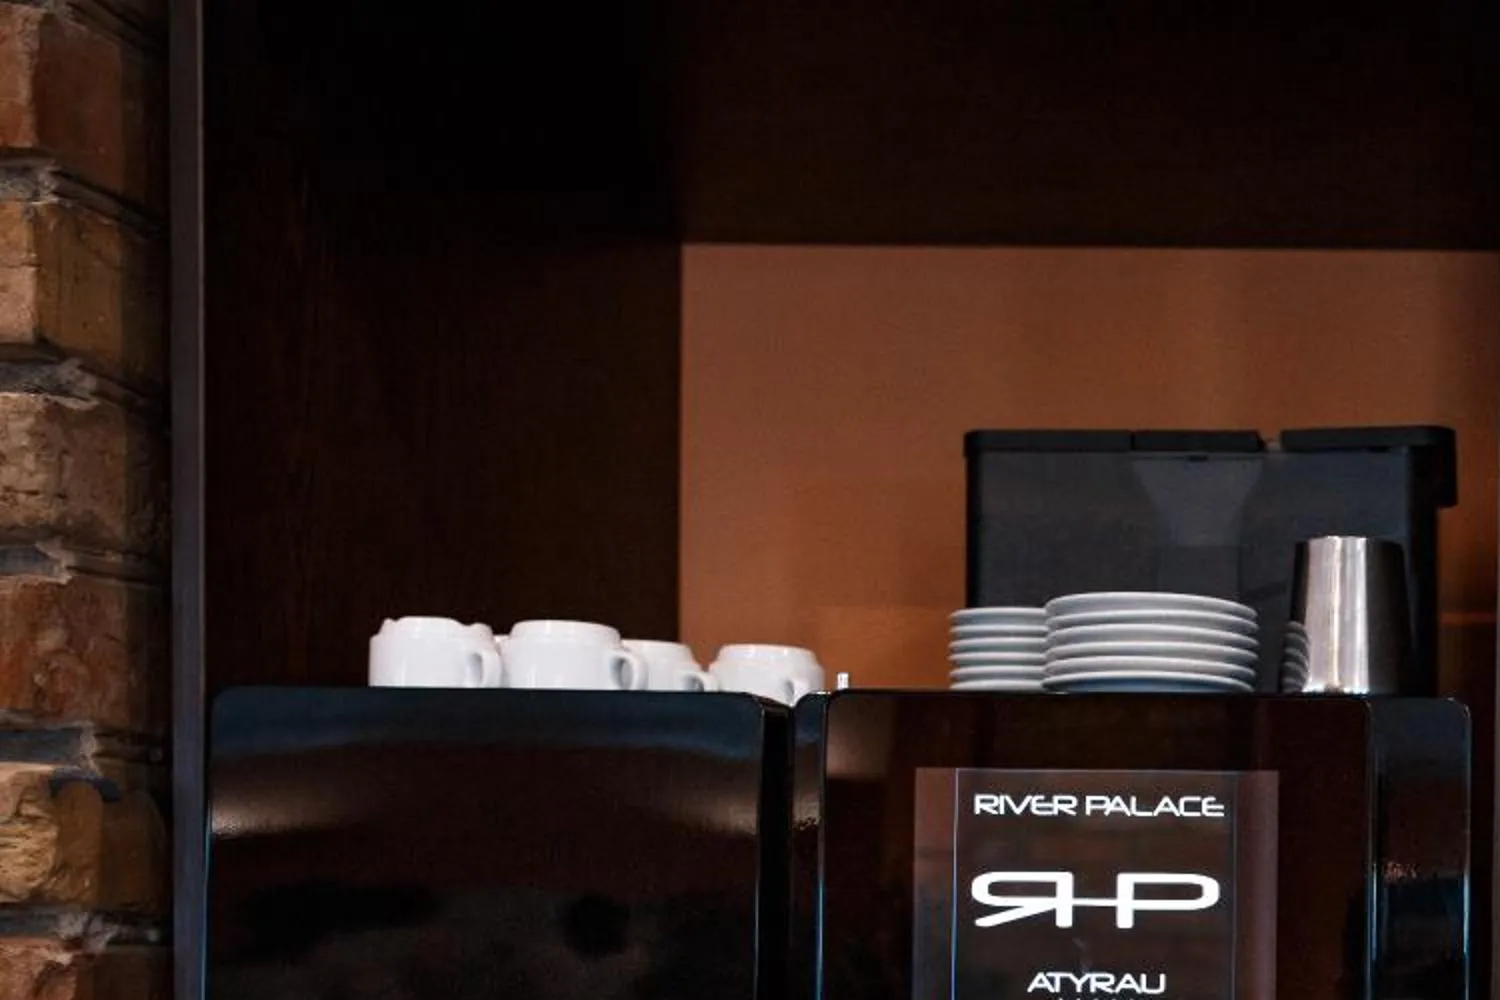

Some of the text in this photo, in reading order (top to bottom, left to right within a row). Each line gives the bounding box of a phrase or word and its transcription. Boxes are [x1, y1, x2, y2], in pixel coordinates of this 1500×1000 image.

[974, 793, 1226, 818] RIVER PALACE
[1026, 972, 1167, 996] ATYRAU
